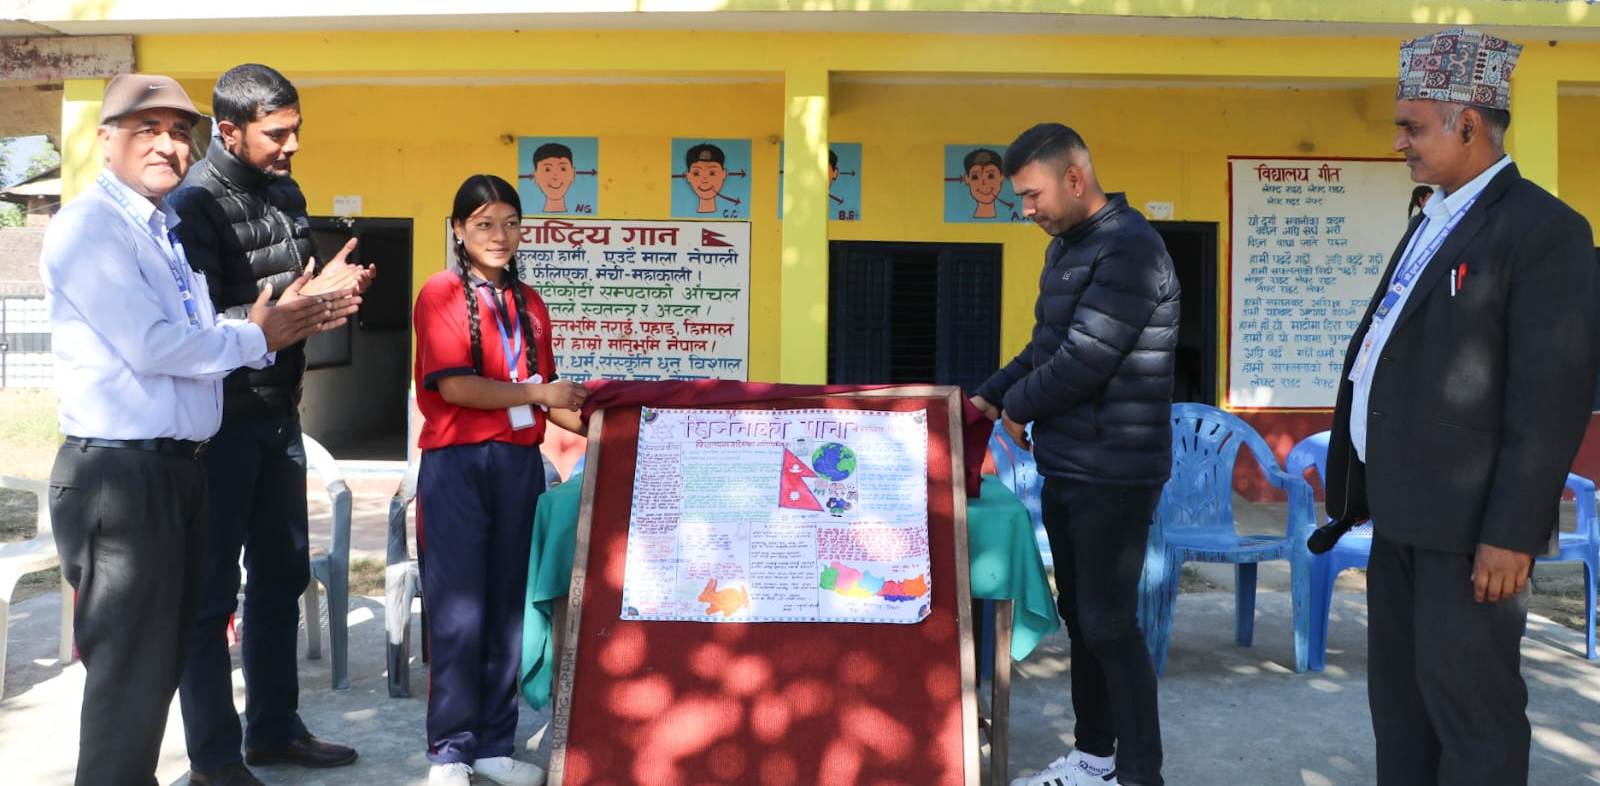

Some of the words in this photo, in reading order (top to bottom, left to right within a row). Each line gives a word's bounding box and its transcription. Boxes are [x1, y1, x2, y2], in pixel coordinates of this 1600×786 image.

[1254, 164, 1311, 182] विद्यालय
[1318, 164, 1342, 183] गीत
[575, 203, 592, 214] NG
[520, 219, 611, 248] राष्ट्रिय
[621, 227, 680, 246] गान
[603, 246, 636, 264] एउटै
[641, 252, 677, 266] माला
[687, 248, 738, 267] नेपाली
[600, 284, 674, 300] सम्पदाको
[581, 302, 638, 318] स्वतन्त्र
[639, 304, 648, 318] र
[656, 303, 701, 318] अटल
[683, 318, 734, 337] हिमाल
[570, 334, 602, 353] हाम्रो
[666, 336, 708, 353] नेपाल
[600, 352, 653, 373] संस्कृति
[688, 354, 742, 373] विशाल
